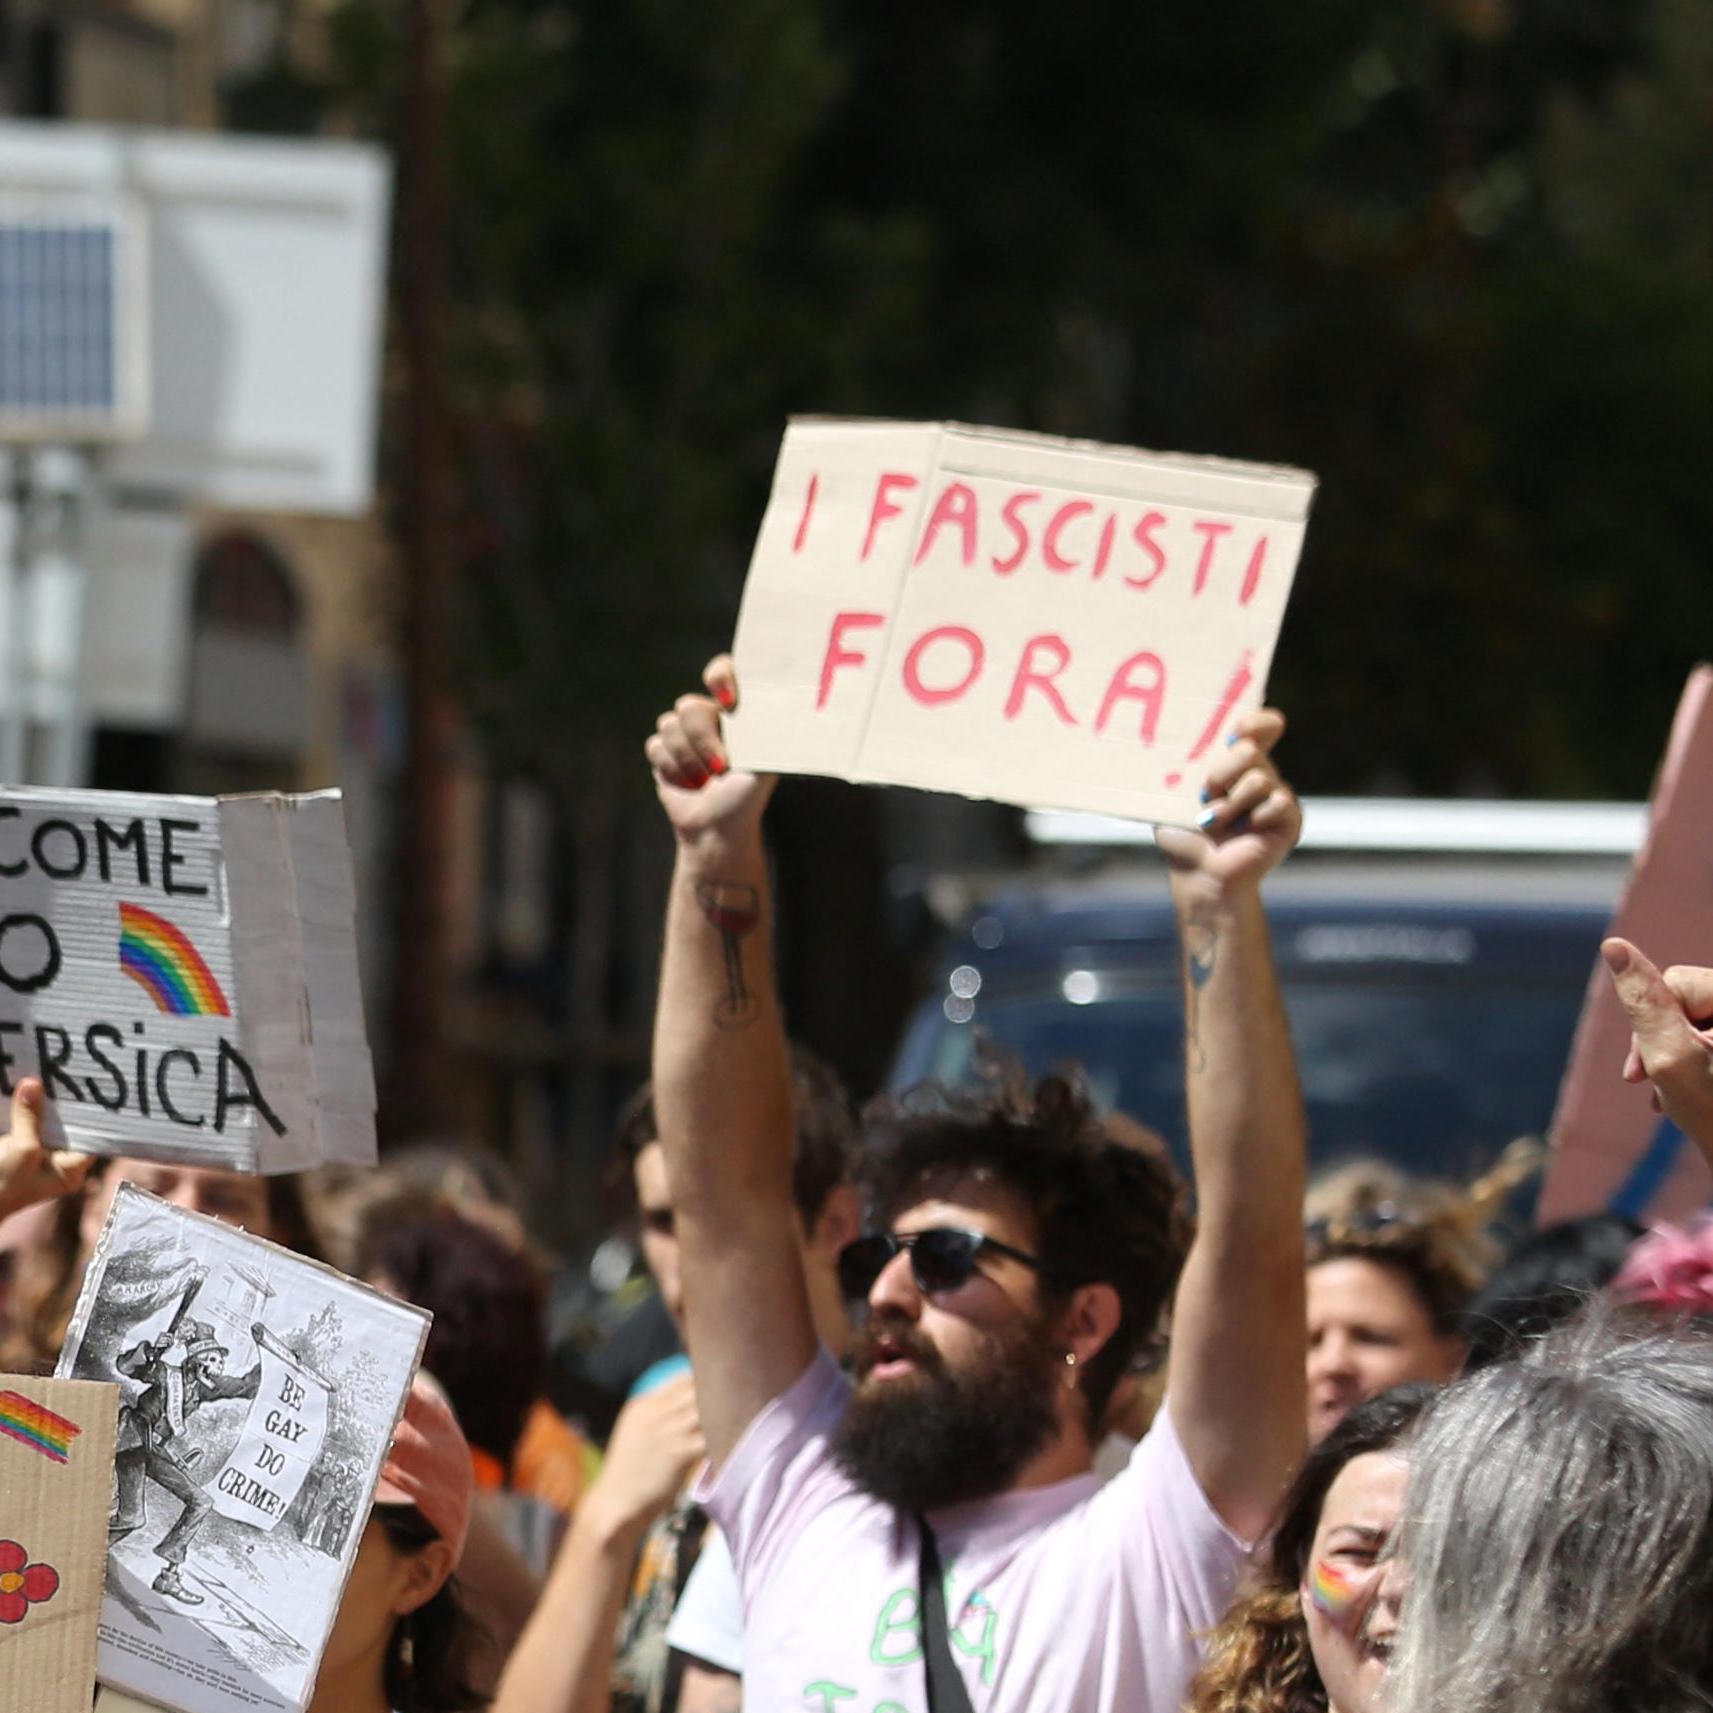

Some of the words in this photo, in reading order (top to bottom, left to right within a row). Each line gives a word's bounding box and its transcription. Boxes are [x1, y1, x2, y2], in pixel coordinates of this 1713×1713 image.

[792, 473, 819, 555] I
[858, 472, 1269, 607] FASCISTI
[815, 611, 1253, 787] FORA!
[277, 1373, 306, 1412] BE
[265, 1409, 308, 1444] GAY
[254, 1443, 286, 1477] DO
[218, 1466, 287, 1520] CRIME!
